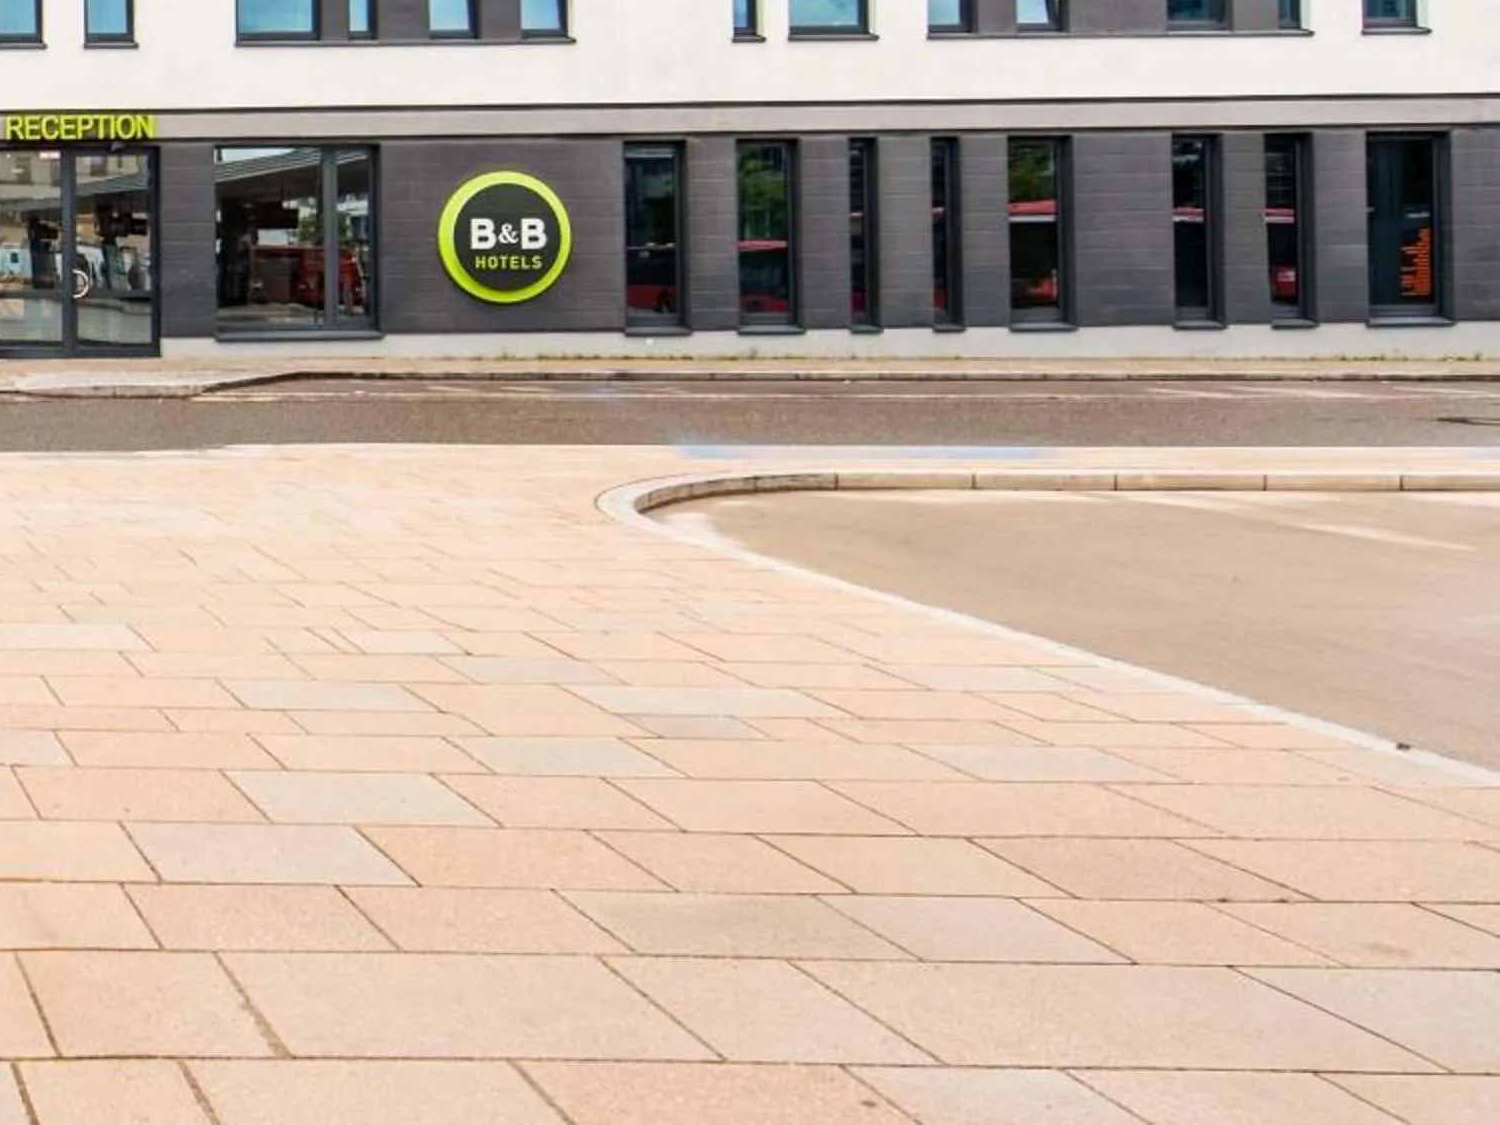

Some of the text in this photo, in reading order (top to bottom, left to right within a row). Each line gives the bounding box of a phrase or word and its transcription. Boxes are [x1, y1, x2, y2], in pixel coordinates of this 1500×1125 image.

[5, 114, 155, 140] RECEPTION
[470, 218, 547, 250] B&B
[475, 256, 543, 270] HOTELS
